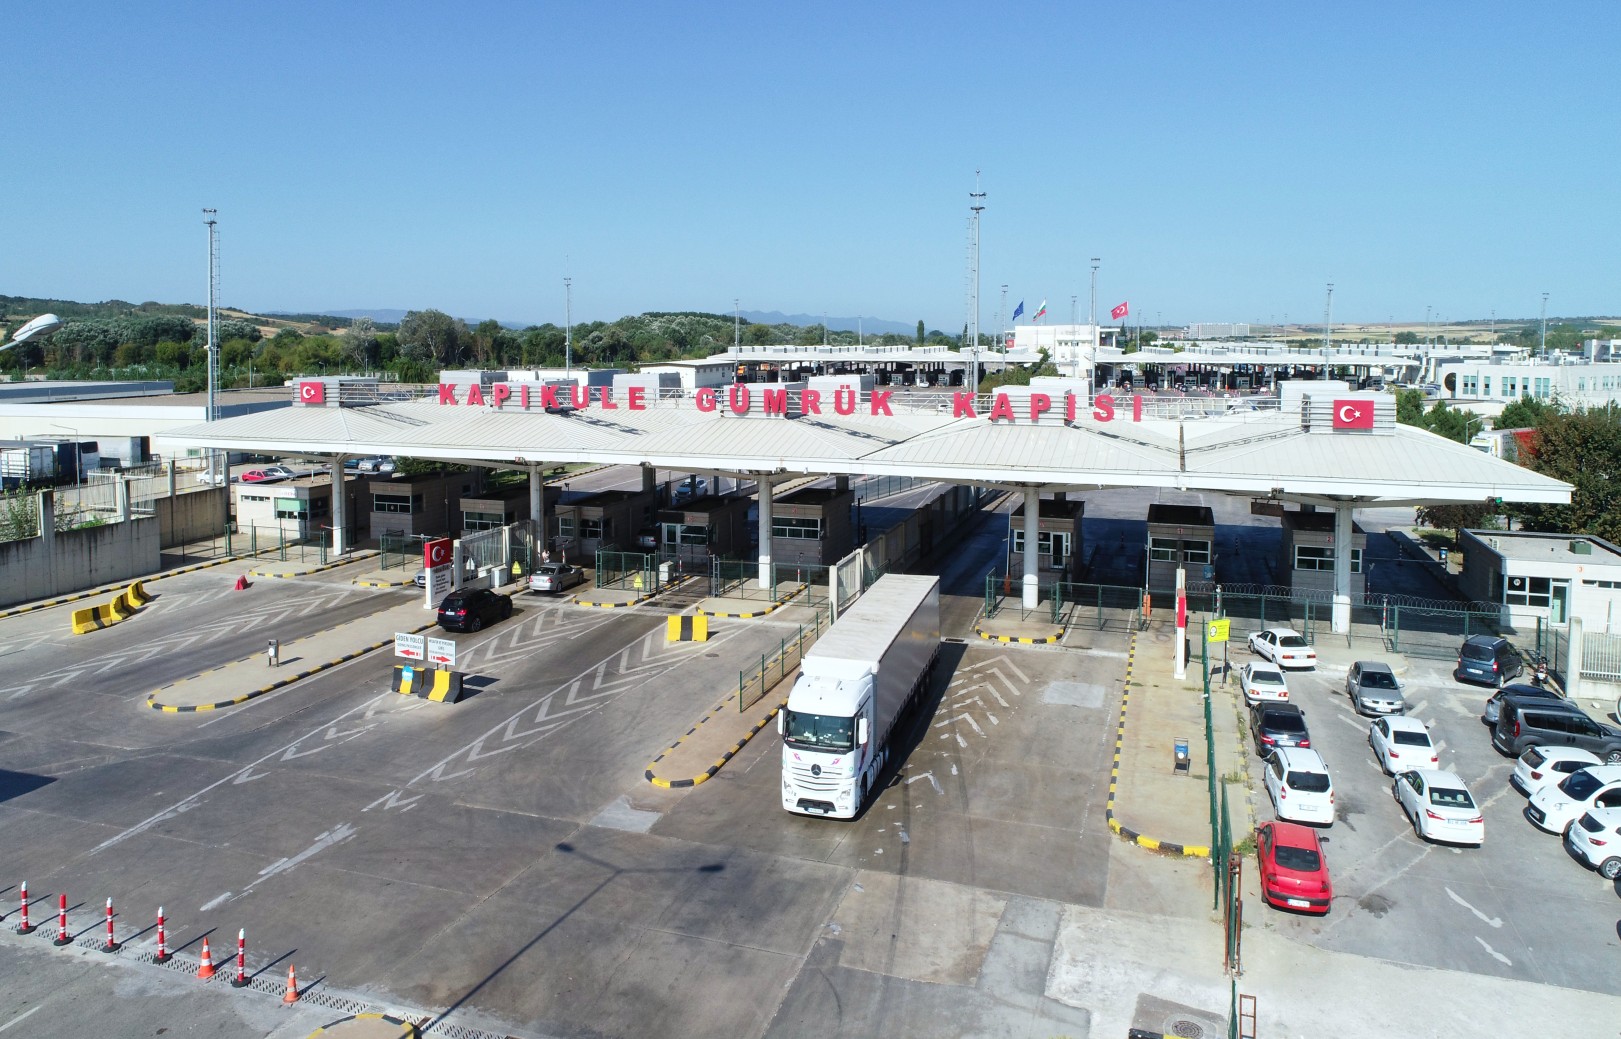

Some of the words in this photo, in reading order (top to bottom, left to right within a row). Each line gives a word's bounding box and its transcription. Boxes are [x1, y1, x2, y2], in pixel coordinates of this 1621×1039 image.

[439, 384, 645, 410] KAPIKULE
[696, 383, 892, 416] GÜMRÜK
[954, 392, 1142, 422] KAPISI
